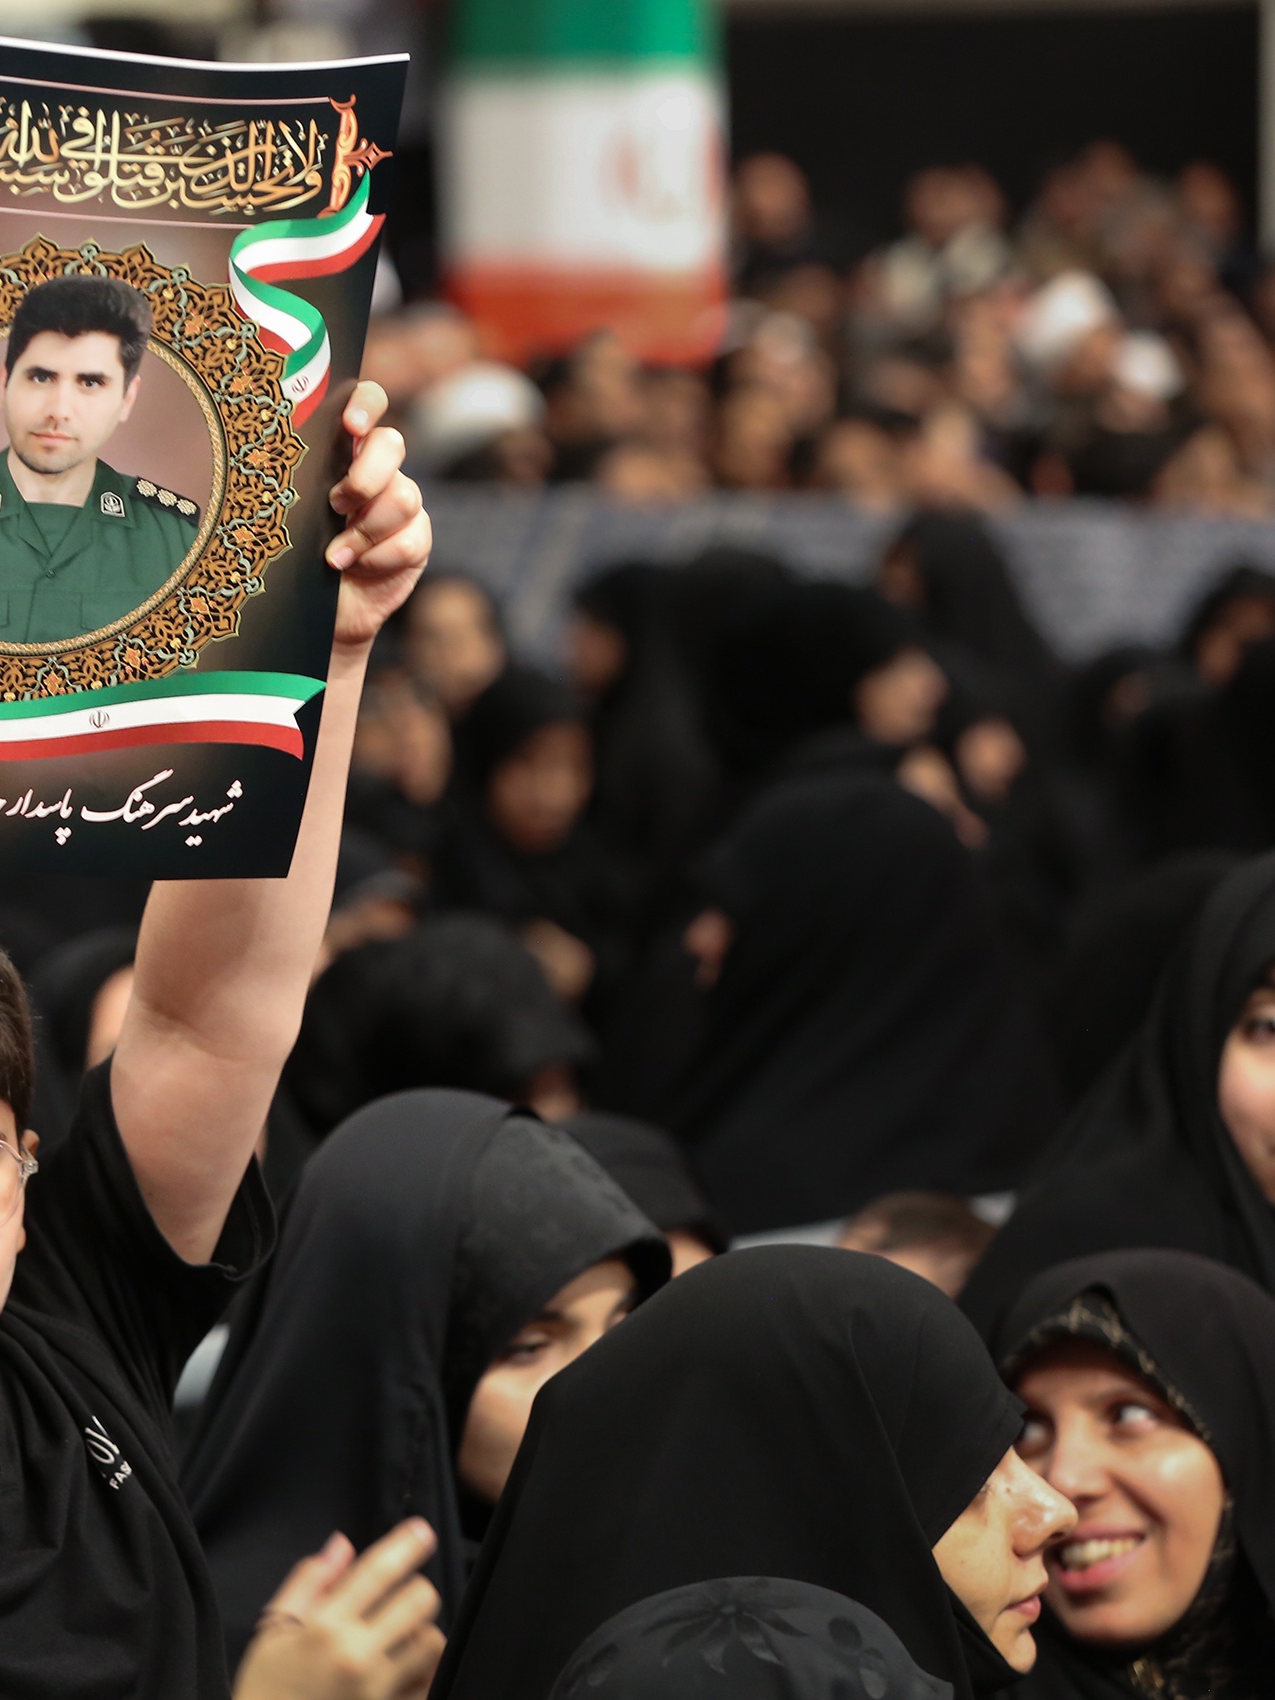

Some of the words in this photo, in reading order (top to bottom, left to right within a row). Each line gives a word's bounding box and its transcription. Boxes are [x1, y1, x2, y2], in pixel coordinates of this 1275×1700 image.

[5, 788, 73, 846] پاسدار
[80, 768, 194, 830] سرهنگ
[178, 779, 243, 847] شهید
